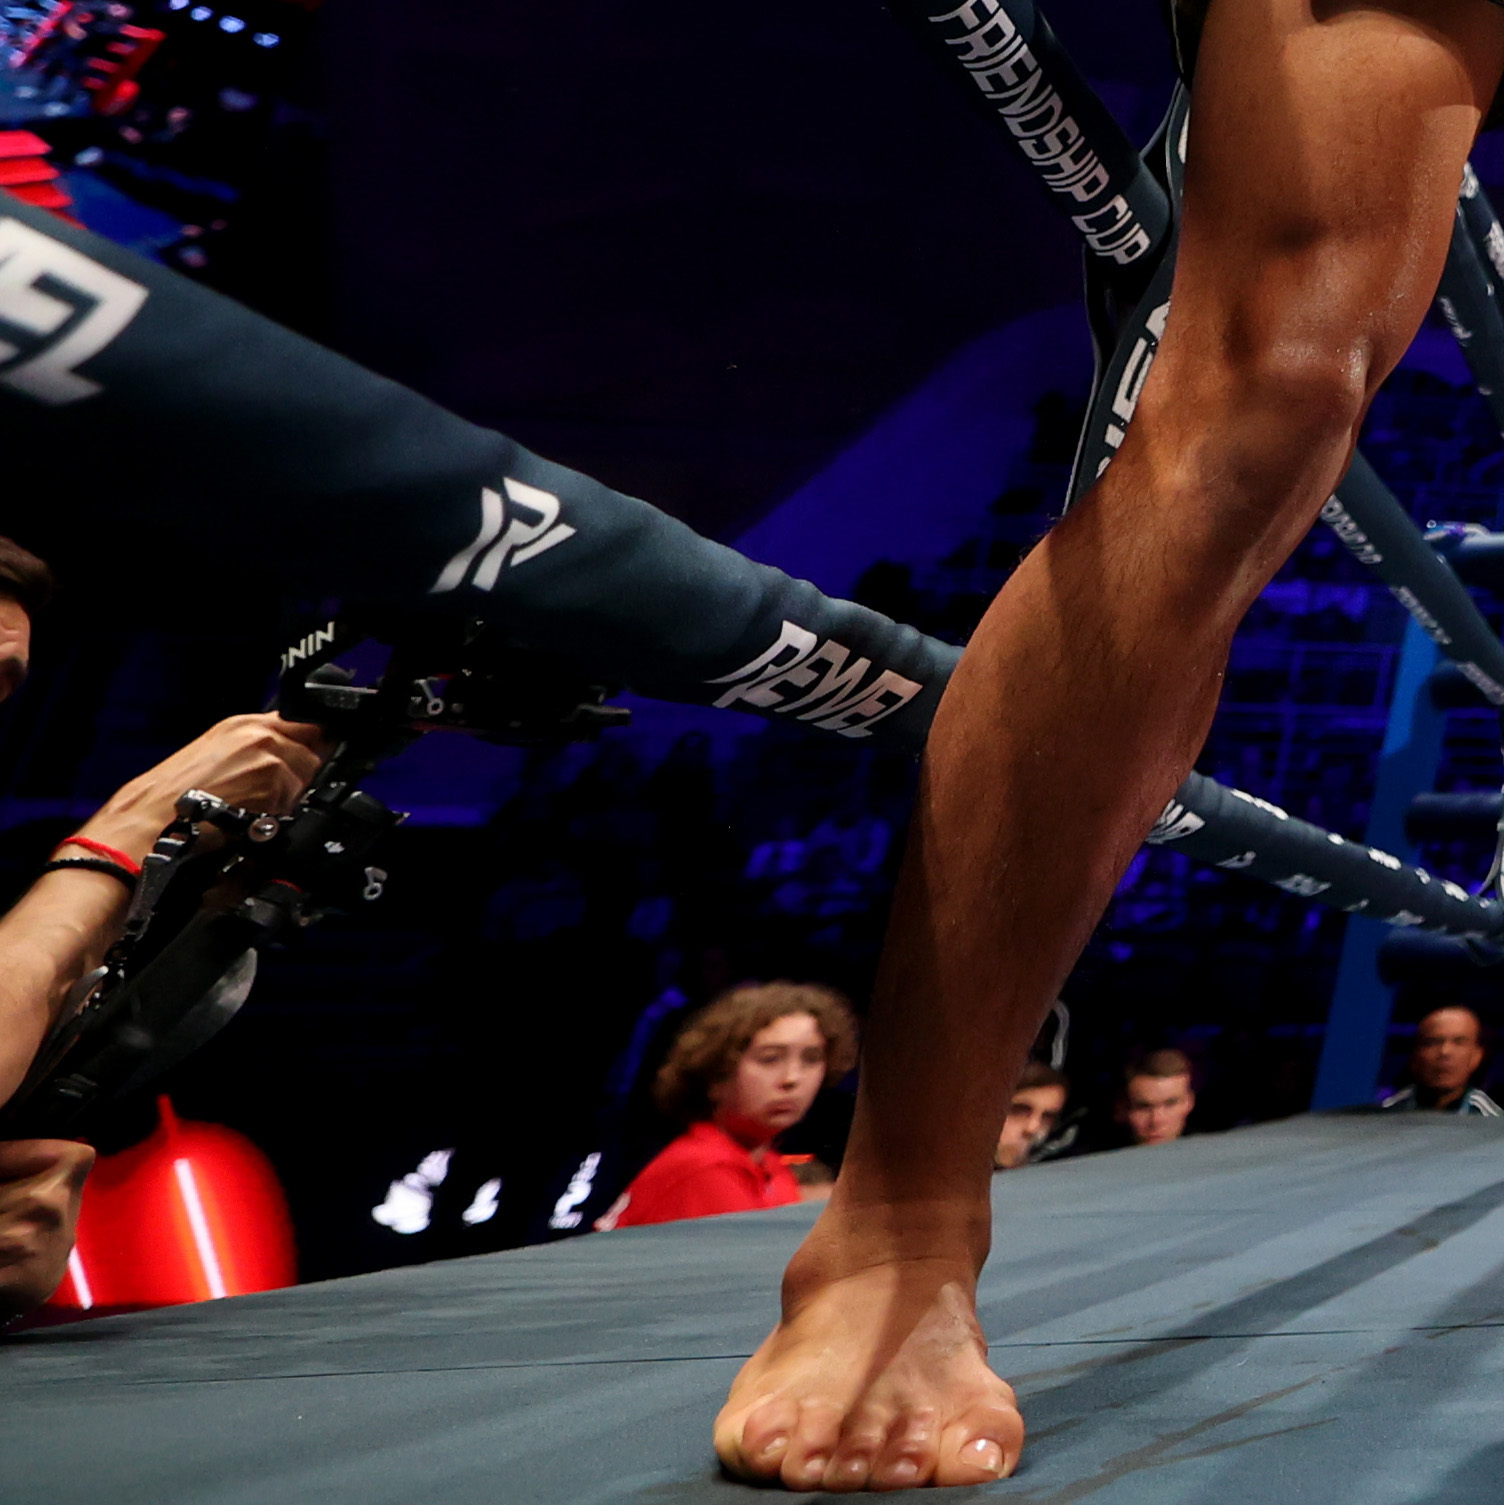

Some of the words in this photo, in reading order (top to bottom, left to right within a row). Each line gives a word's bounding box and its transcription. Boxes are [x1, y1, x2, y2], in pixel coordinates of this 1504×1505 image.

[1071, 194, 1151, 265] CUP
[280, 620, 336, 676] NIN
[702, 619, 924, 738] REYVEL
